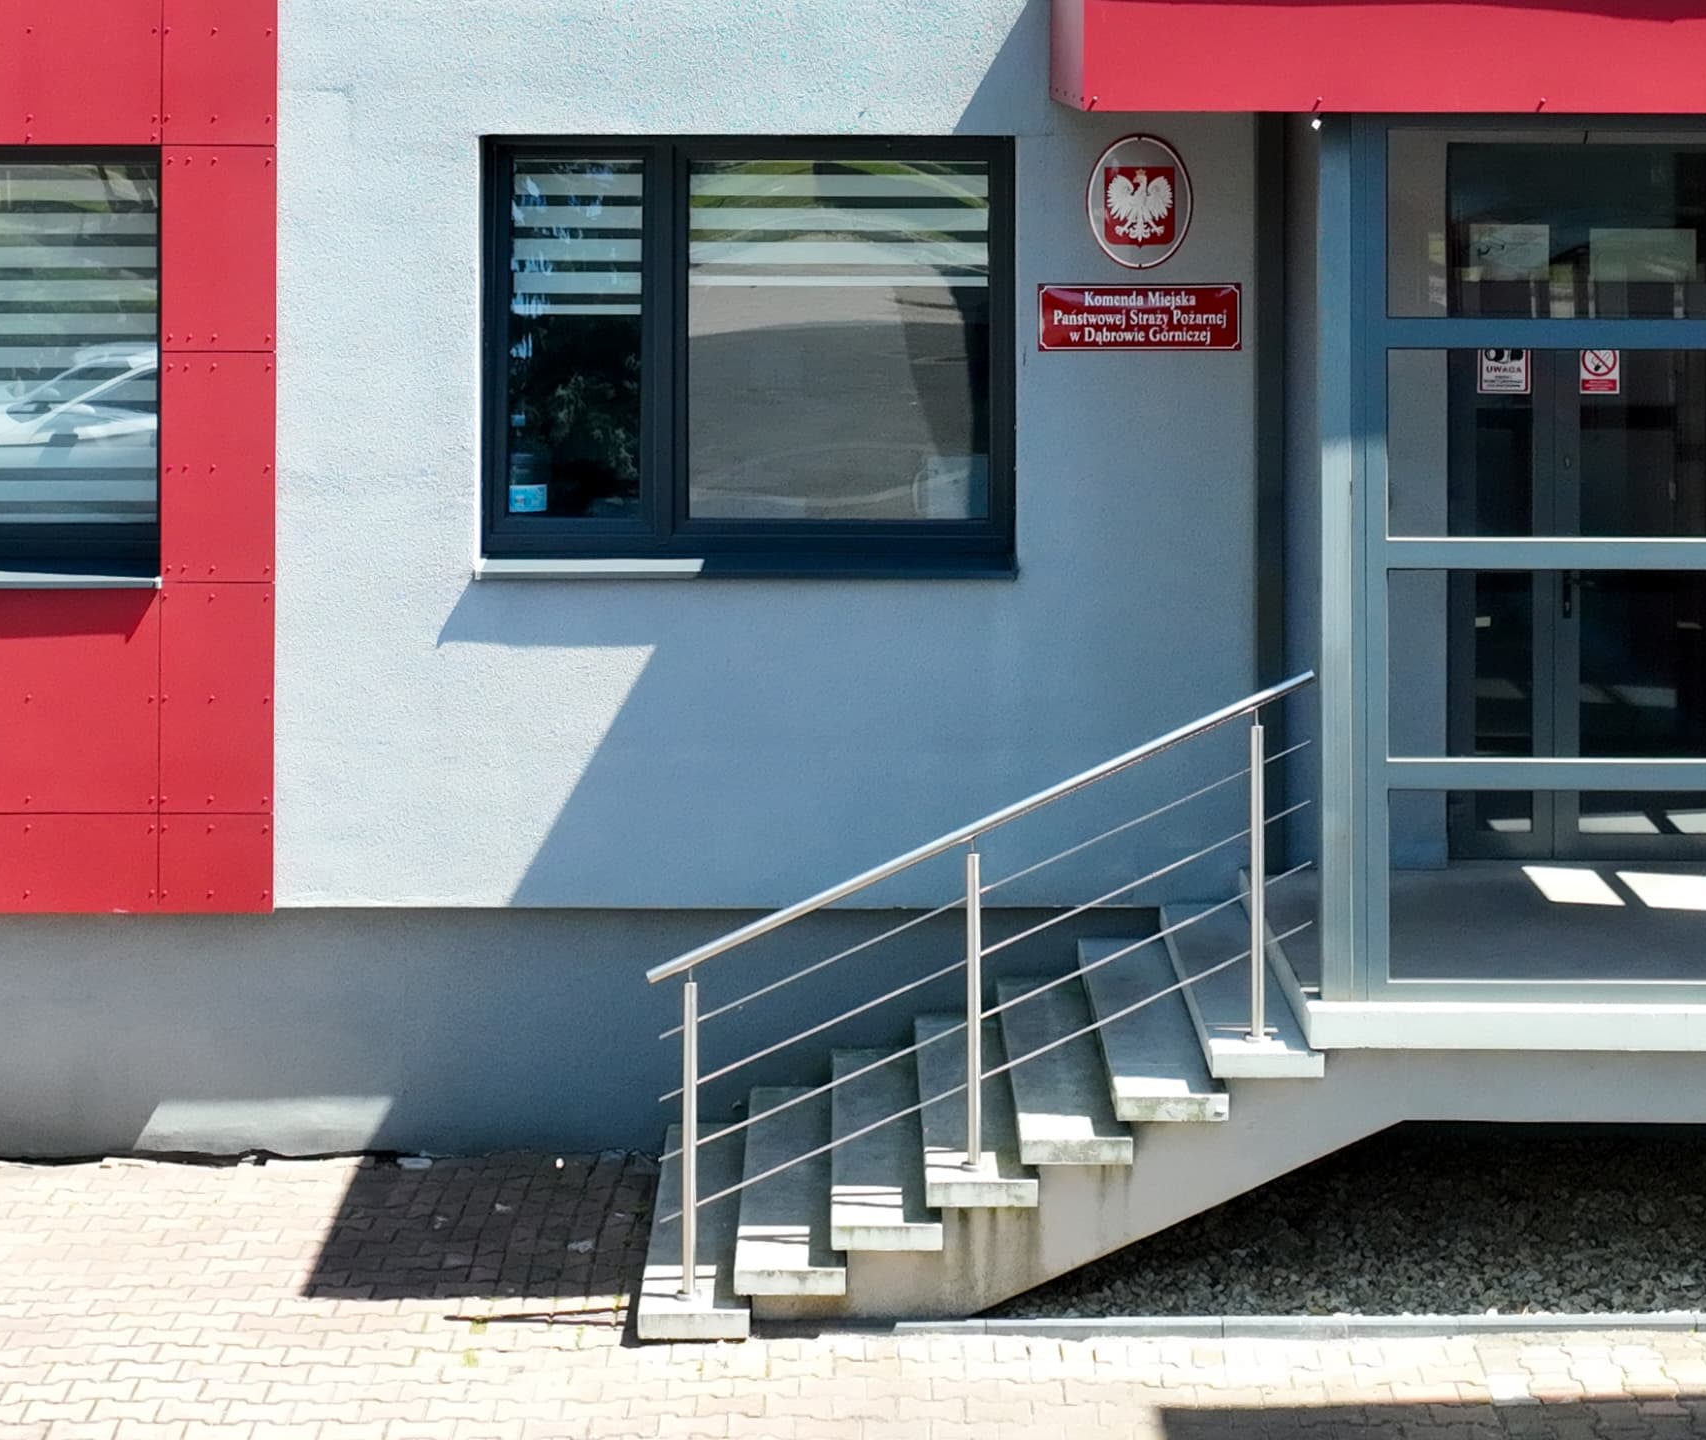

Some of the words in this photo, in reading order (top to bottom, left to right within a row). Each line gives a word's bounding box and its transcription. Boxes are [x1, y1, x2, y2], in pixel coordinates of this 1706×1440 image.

[1084, 291, 1143, 306] Komenda
[1148, 291, 1196, 310] Miejska
[1053, 309, 1126, 329] Państwowej
[1130, 309, 1169, 328] Straży
[1173, 309, 1227, 329] Pożarnej
[1069, 331, 1081, 342] w
[1084, 326, 1145, 345] Dąbrowie
[1149, 326, 1211, 345] Górniczej
[1486, 365, 1522, 373] UWAGA
